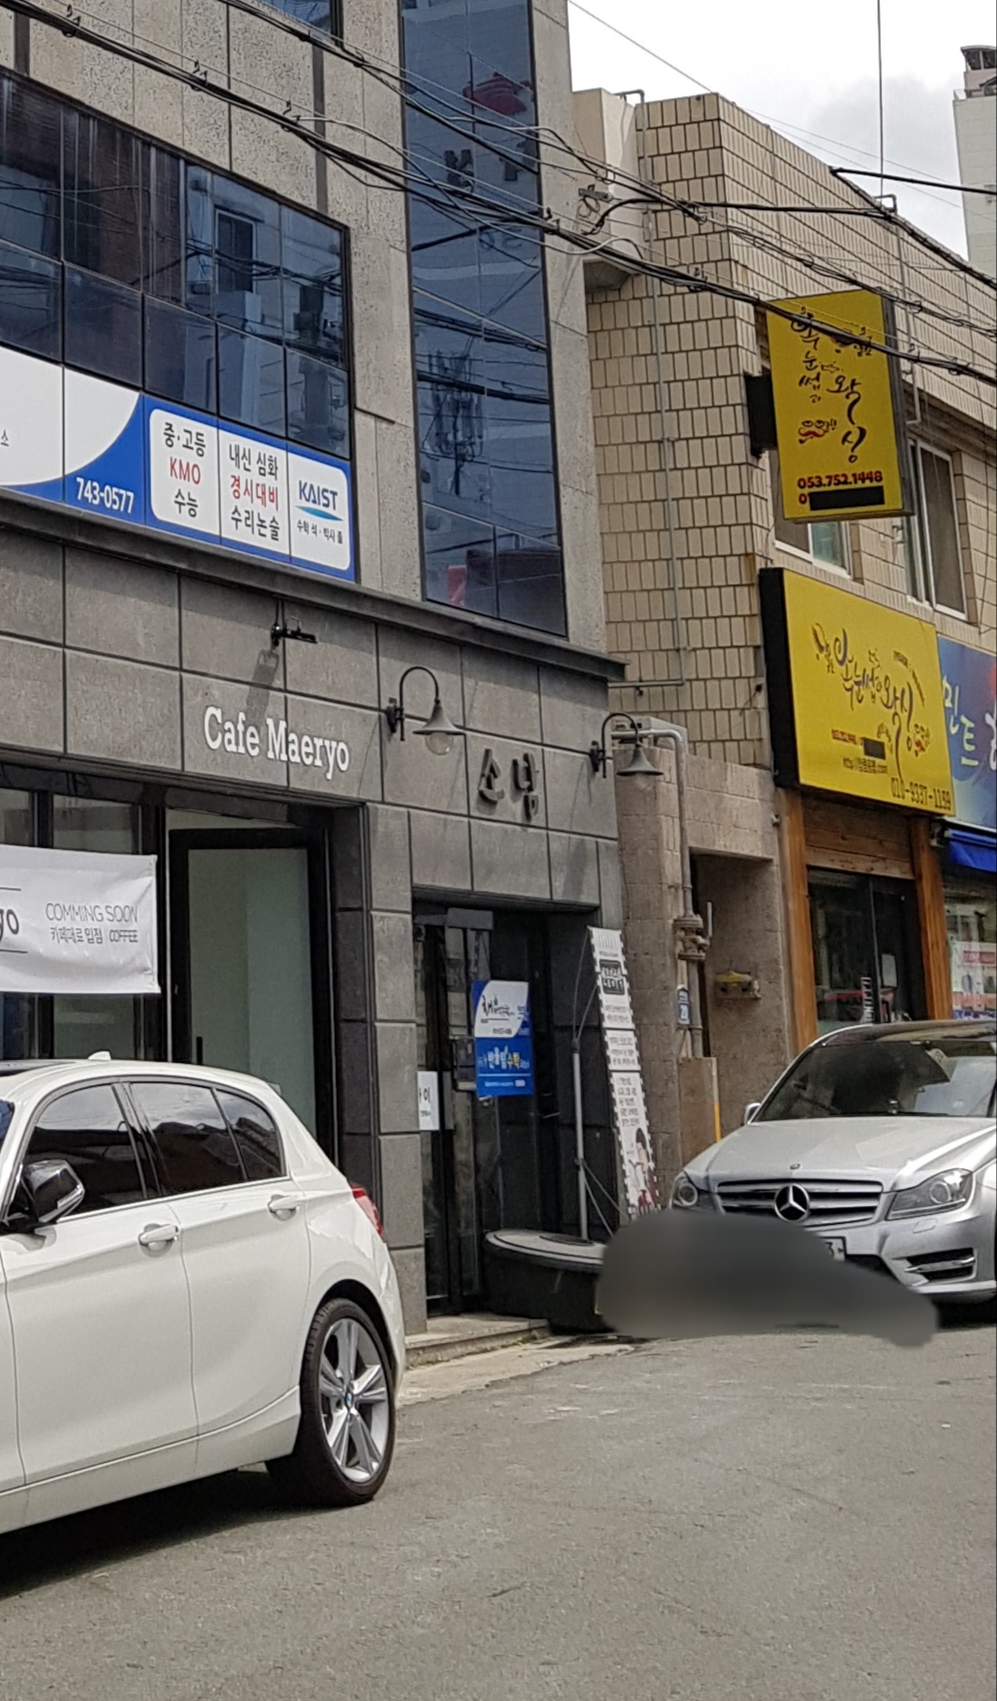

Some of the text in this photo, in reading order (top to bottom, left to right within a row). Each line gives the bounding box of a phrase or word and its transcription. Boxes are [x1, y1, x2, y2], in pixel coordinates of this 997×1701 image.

[163, 421, 206, 457] 중·고등
[169, 456, 201, 485] KMO
[228, 443, 279, 481] 내신 심화
[76, 476, 135, 515] 743-0577
[230, 474, 279, 512] 경시대비
[298, 479, 338, 511] KAIST
[797, 470, 883, 490] 053.752.1448
[174, 488, 199, 518] 수능
[230, 504, 281, 542] 수리논술
[203, 705, 350, 781] Cafe Maeryo
[45, 902, 138, 923] COMMING SOON
[108, 929, 139, 943] COFFEE
